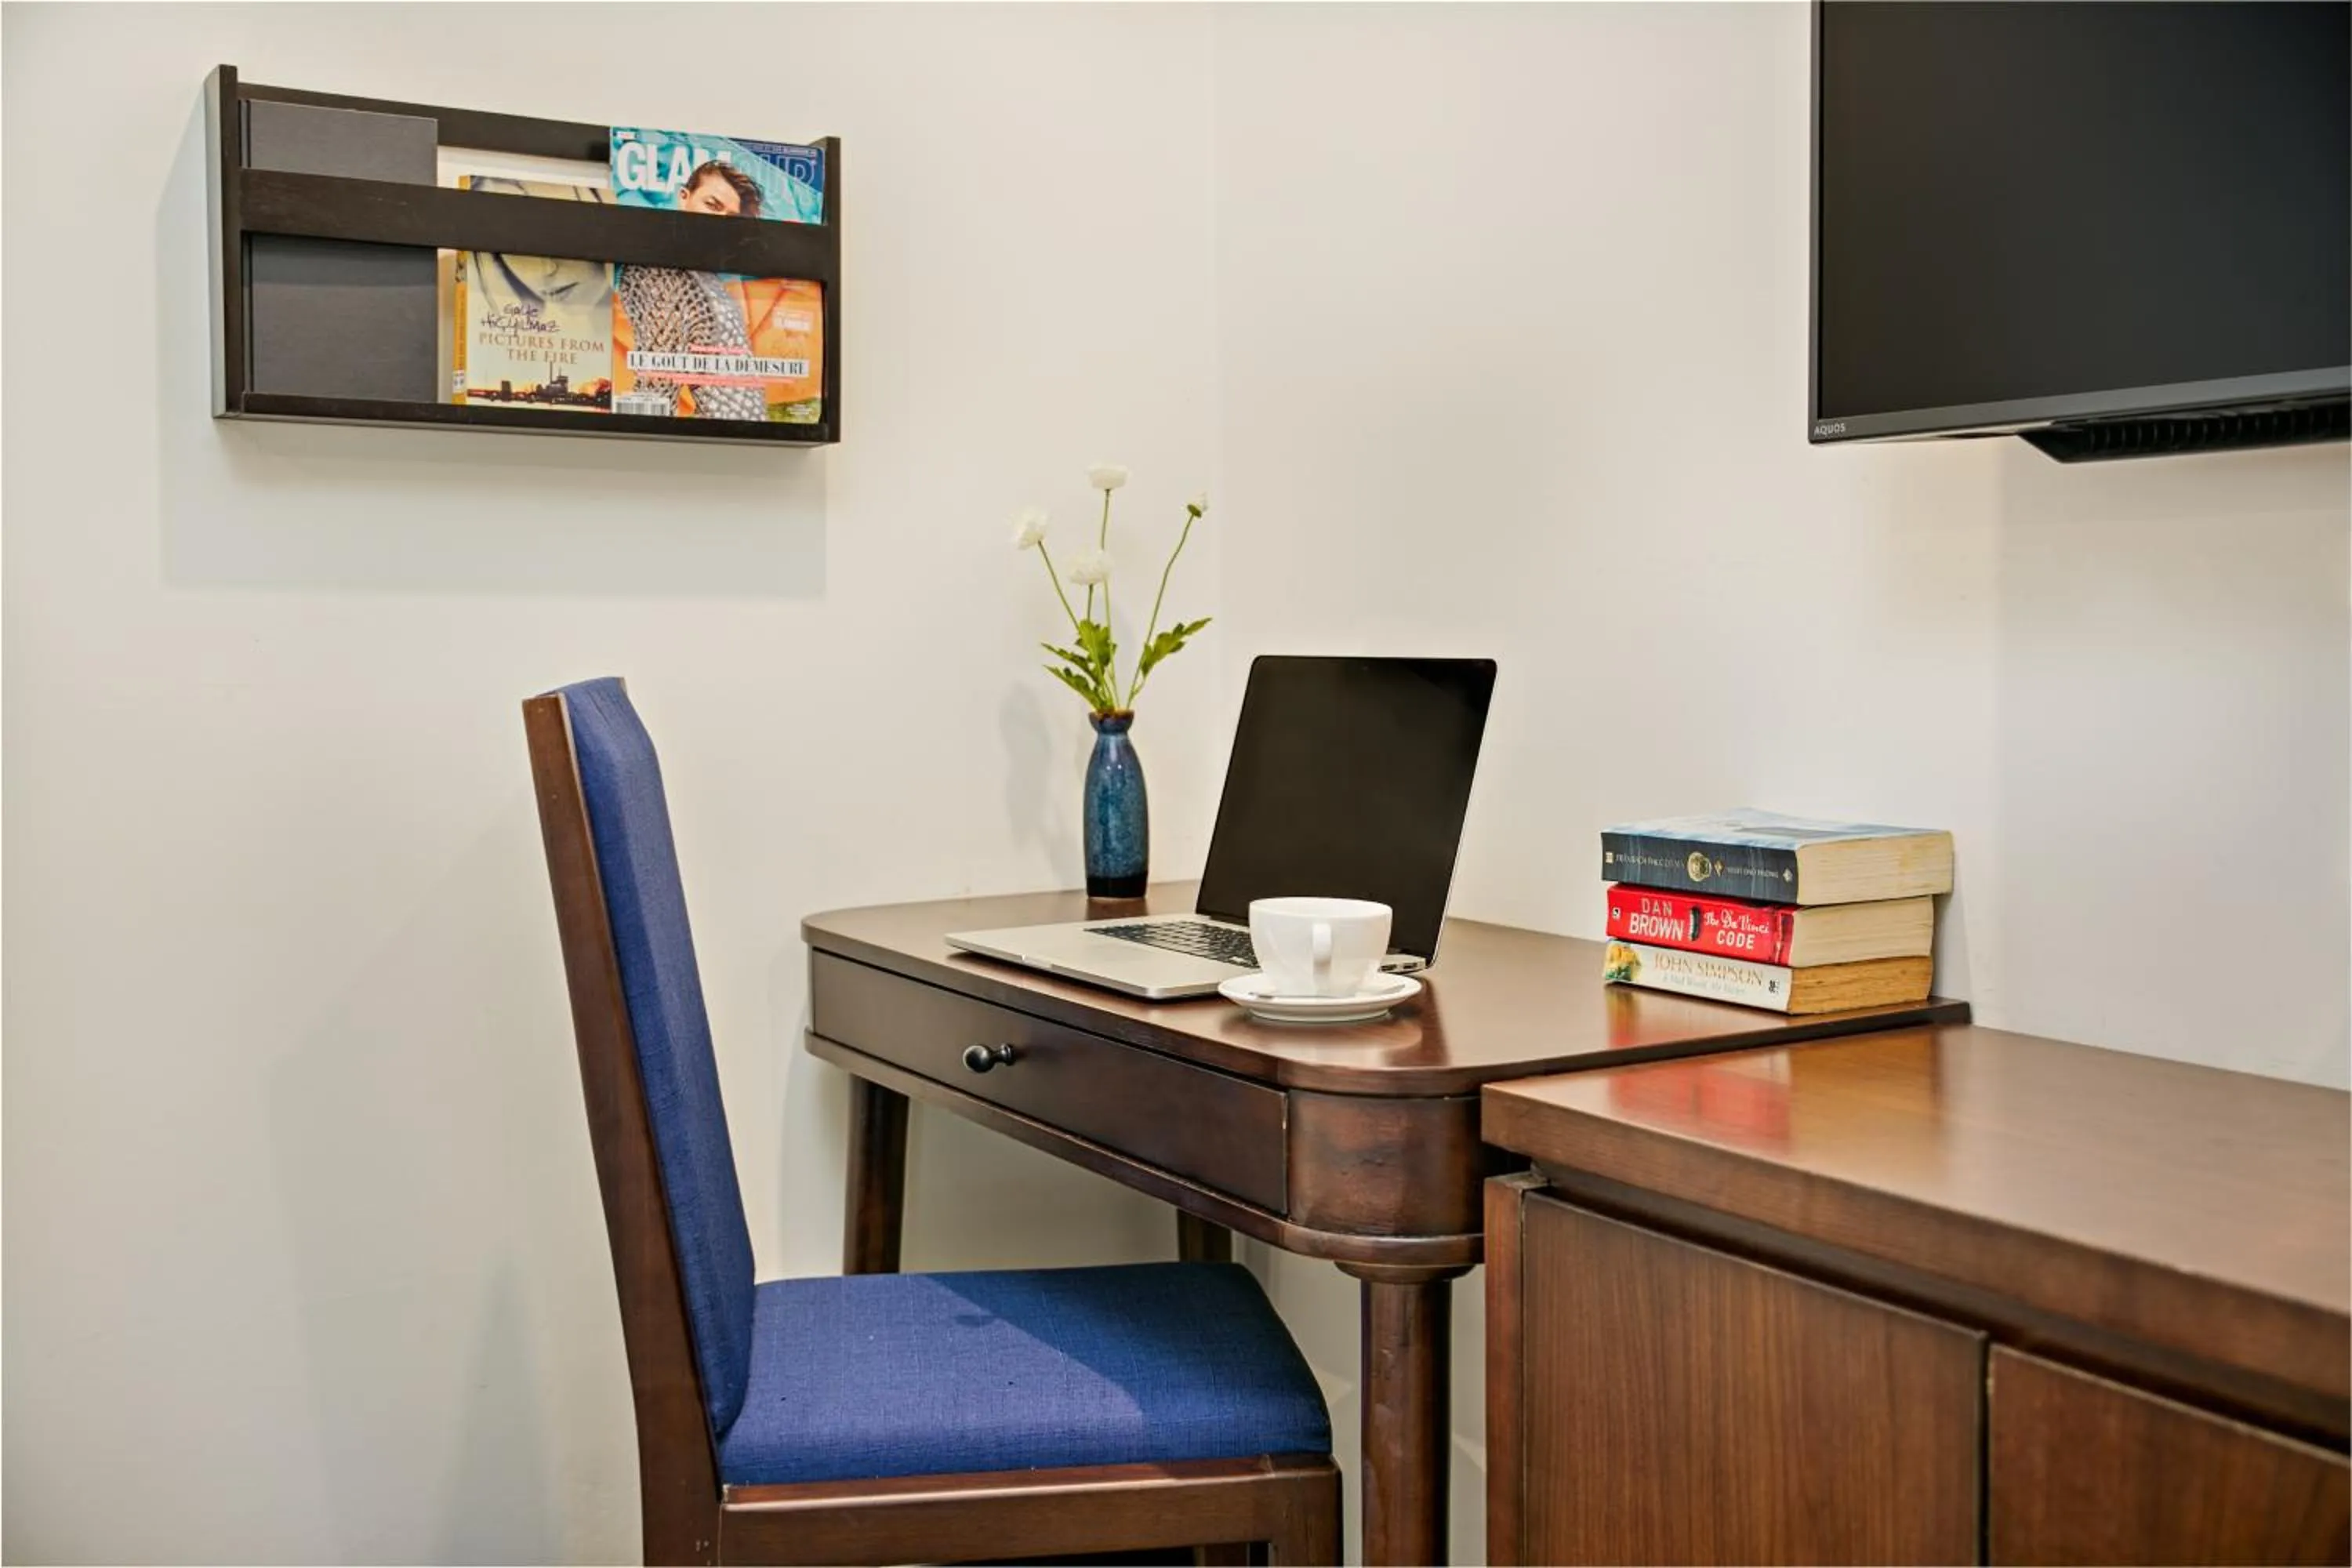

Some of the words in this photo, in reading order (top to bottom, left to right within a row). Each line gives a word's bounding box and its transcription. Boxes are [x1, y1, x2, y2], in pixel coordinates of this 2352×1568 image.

[479, 332, 554, 350] PICTURES
[561, 337, 604, 352] FROM
[508, 349, 536, 361] THE
[545, 352, 578, 365] FIRE
[1813, 423, 1846, 436] AQUOS
[1642, 898, 1672, 915] DAN
[1629, 913, 1684, 941] BROWN
[1704, 912, 1719, 926] The
[1738, 915, 1769, 934] Vinci
[1716, 930, 1756, 950] CODE
[1654, 952, 1693, 974] JOHN
[1696, 959, 1763, 986] SIMPSON
